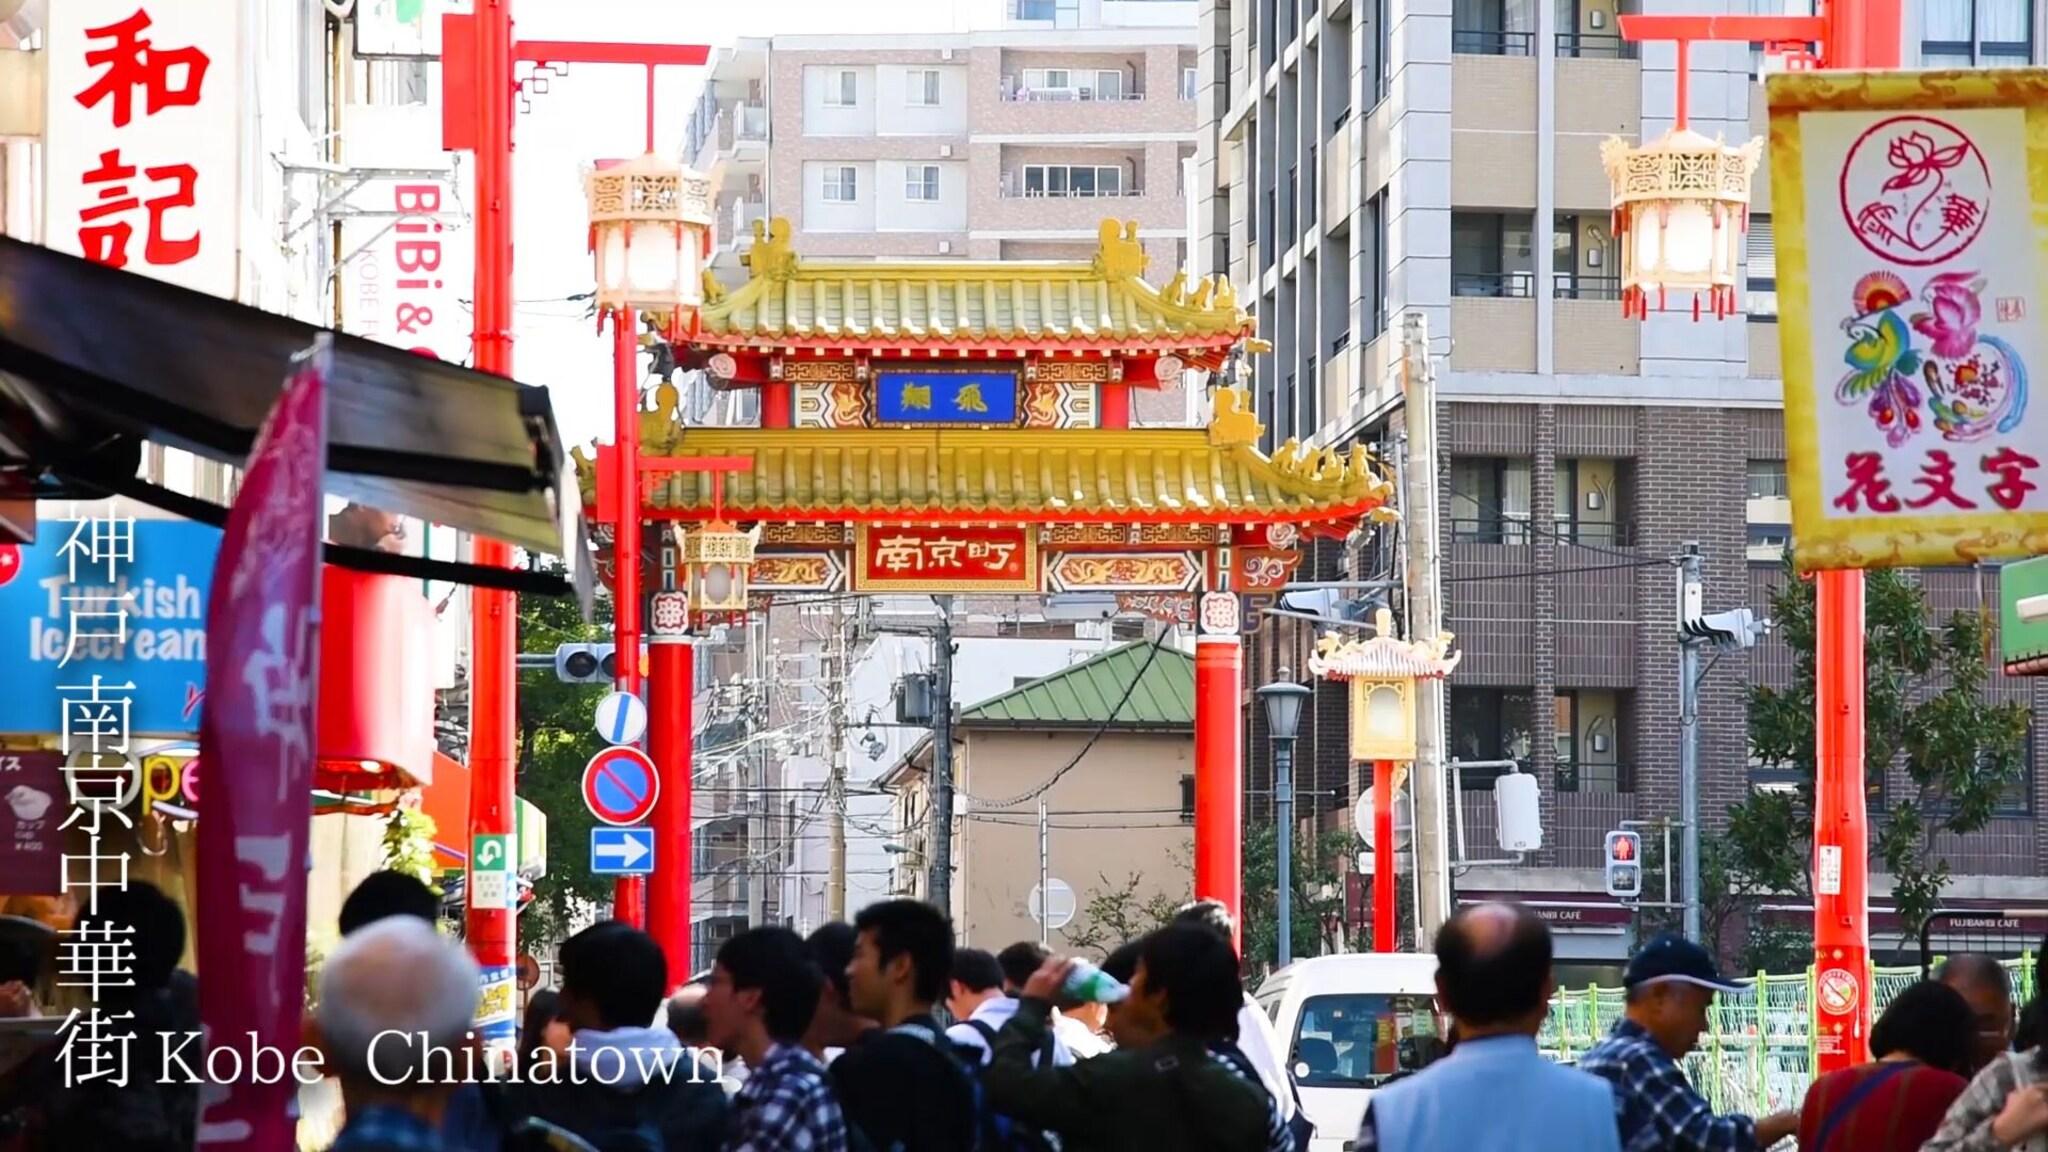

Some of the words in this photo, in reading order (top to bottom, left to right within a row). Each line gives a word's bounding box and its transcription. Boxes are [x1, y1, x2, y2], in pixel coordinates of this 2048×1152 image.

[74, 8, 210, 270] 和記
[395, 185, 443, 288] BiBi
[360, 250, 378, 310] KOBE
[396, 302, 434, 334] &
[1833, 447, 2039, 513] 花文字
[875, 534, 1016, 572] 南京町
[38, 574, 200, 619] Turkish
